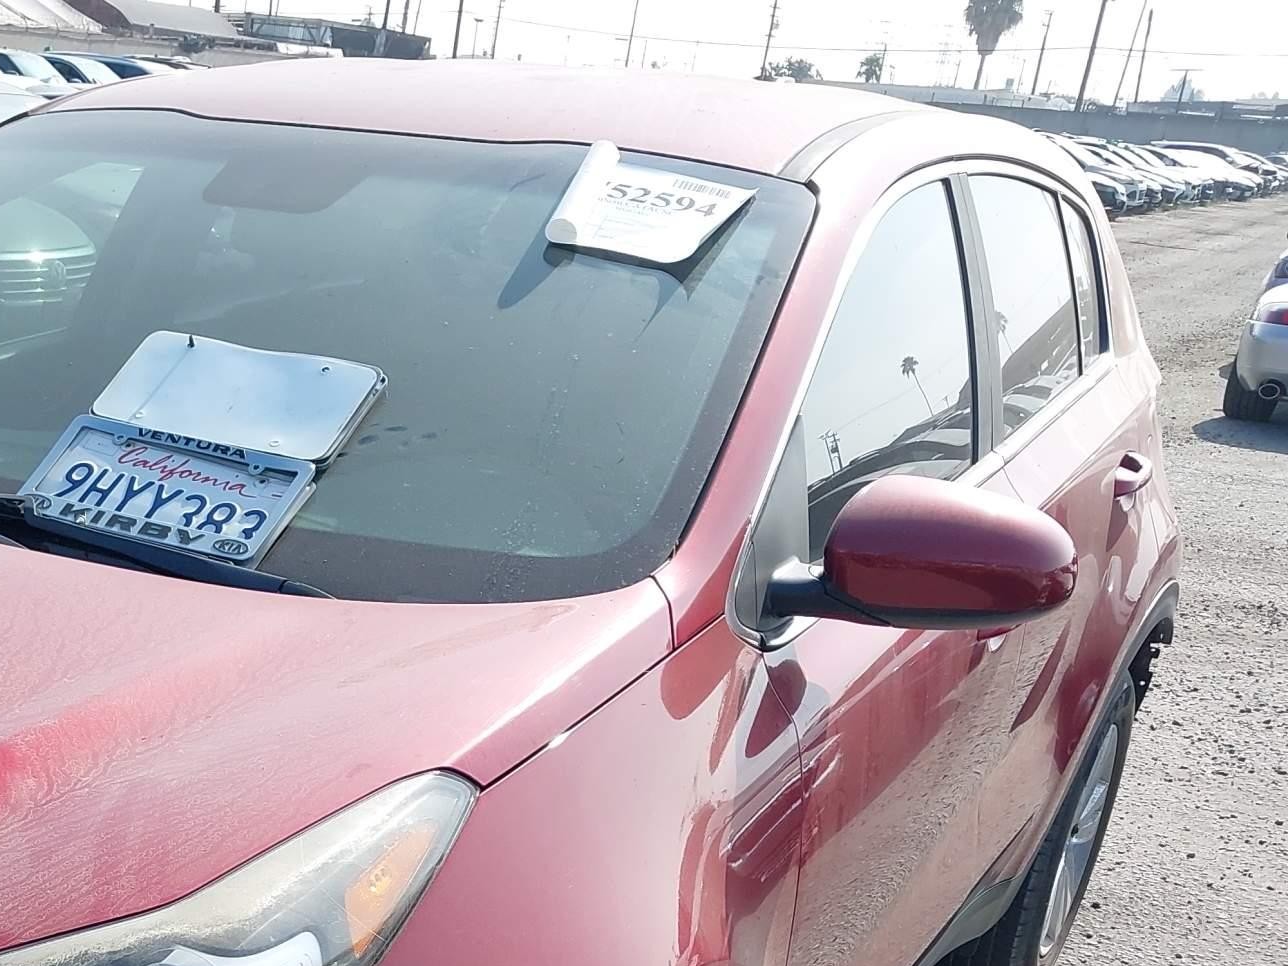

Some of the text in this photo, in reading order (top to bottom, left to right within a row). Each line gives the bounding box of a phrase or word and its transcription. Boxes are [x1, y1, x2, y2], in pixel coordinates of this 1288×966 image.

[606, 181, 717, 217] 52594
[138, 428, 245, 460] VENTURA
[118, 446, 257, 498] California
[54, 462, 268, 540] 9HYY383
[59, 503, 206, 546] KIRBY
